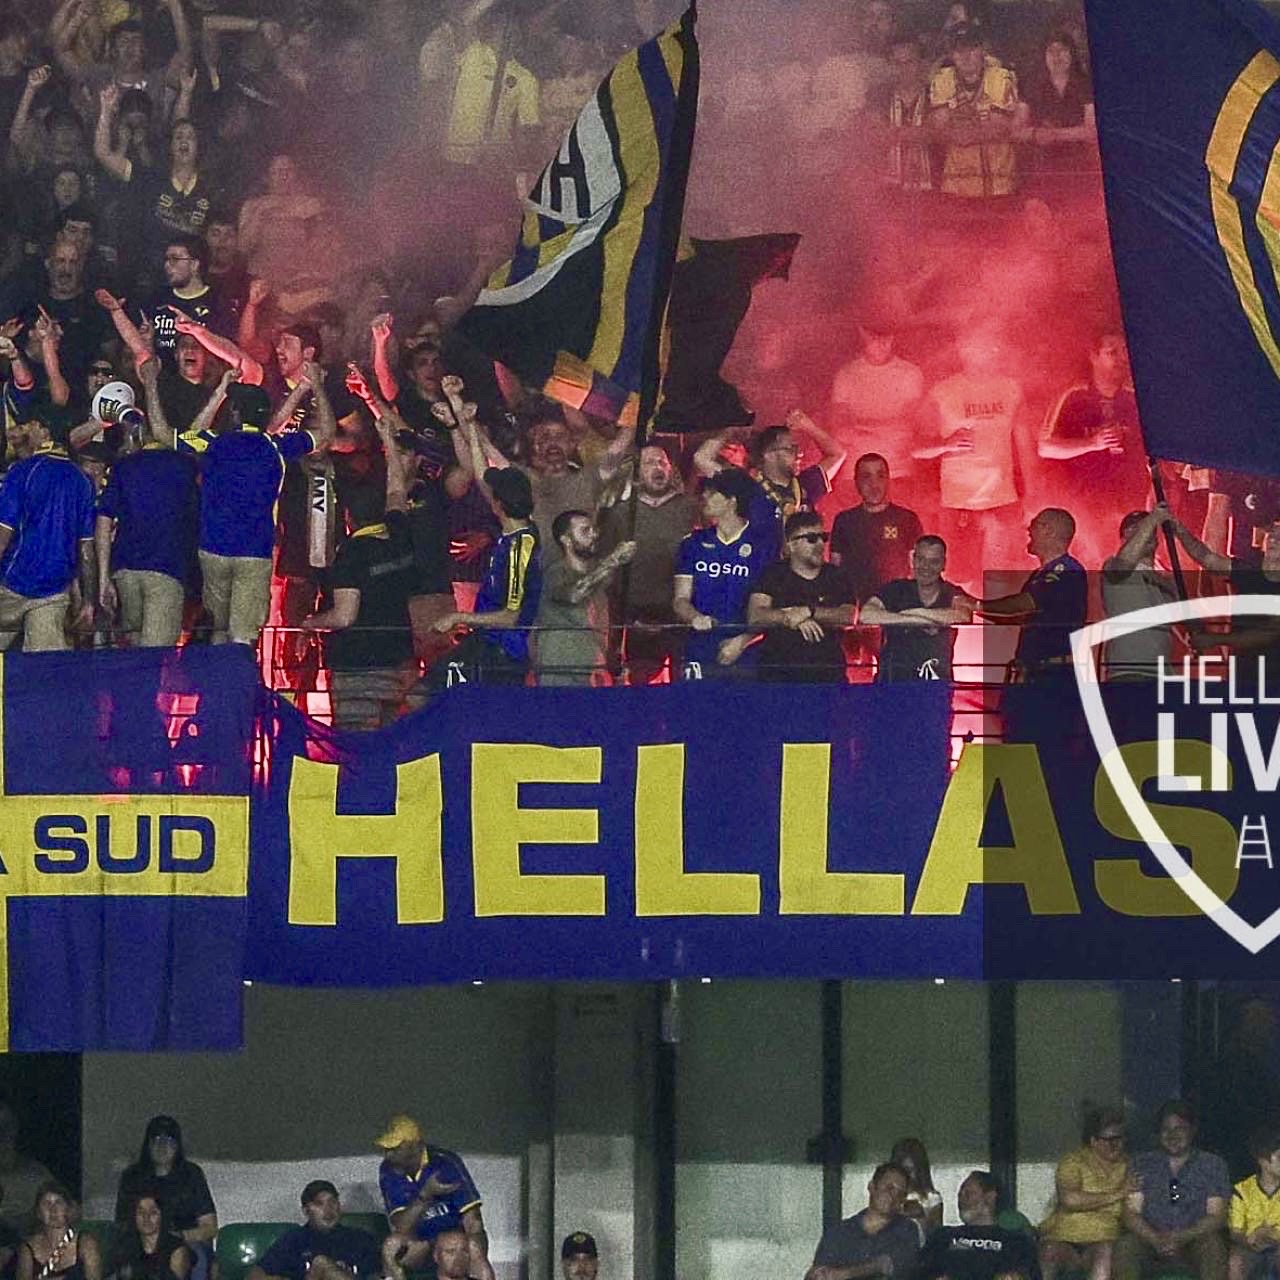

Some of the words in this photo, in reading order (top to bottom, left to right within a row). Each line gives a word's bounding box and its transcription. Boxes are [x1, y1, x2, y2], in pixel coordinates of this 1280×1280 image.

[964, 402, 1004, 418] HELLAS
[696, 561, 750, 578] agsm
[34, 814, 216, 874] SUD
[287, 742, 1238, 926] HELLAS
